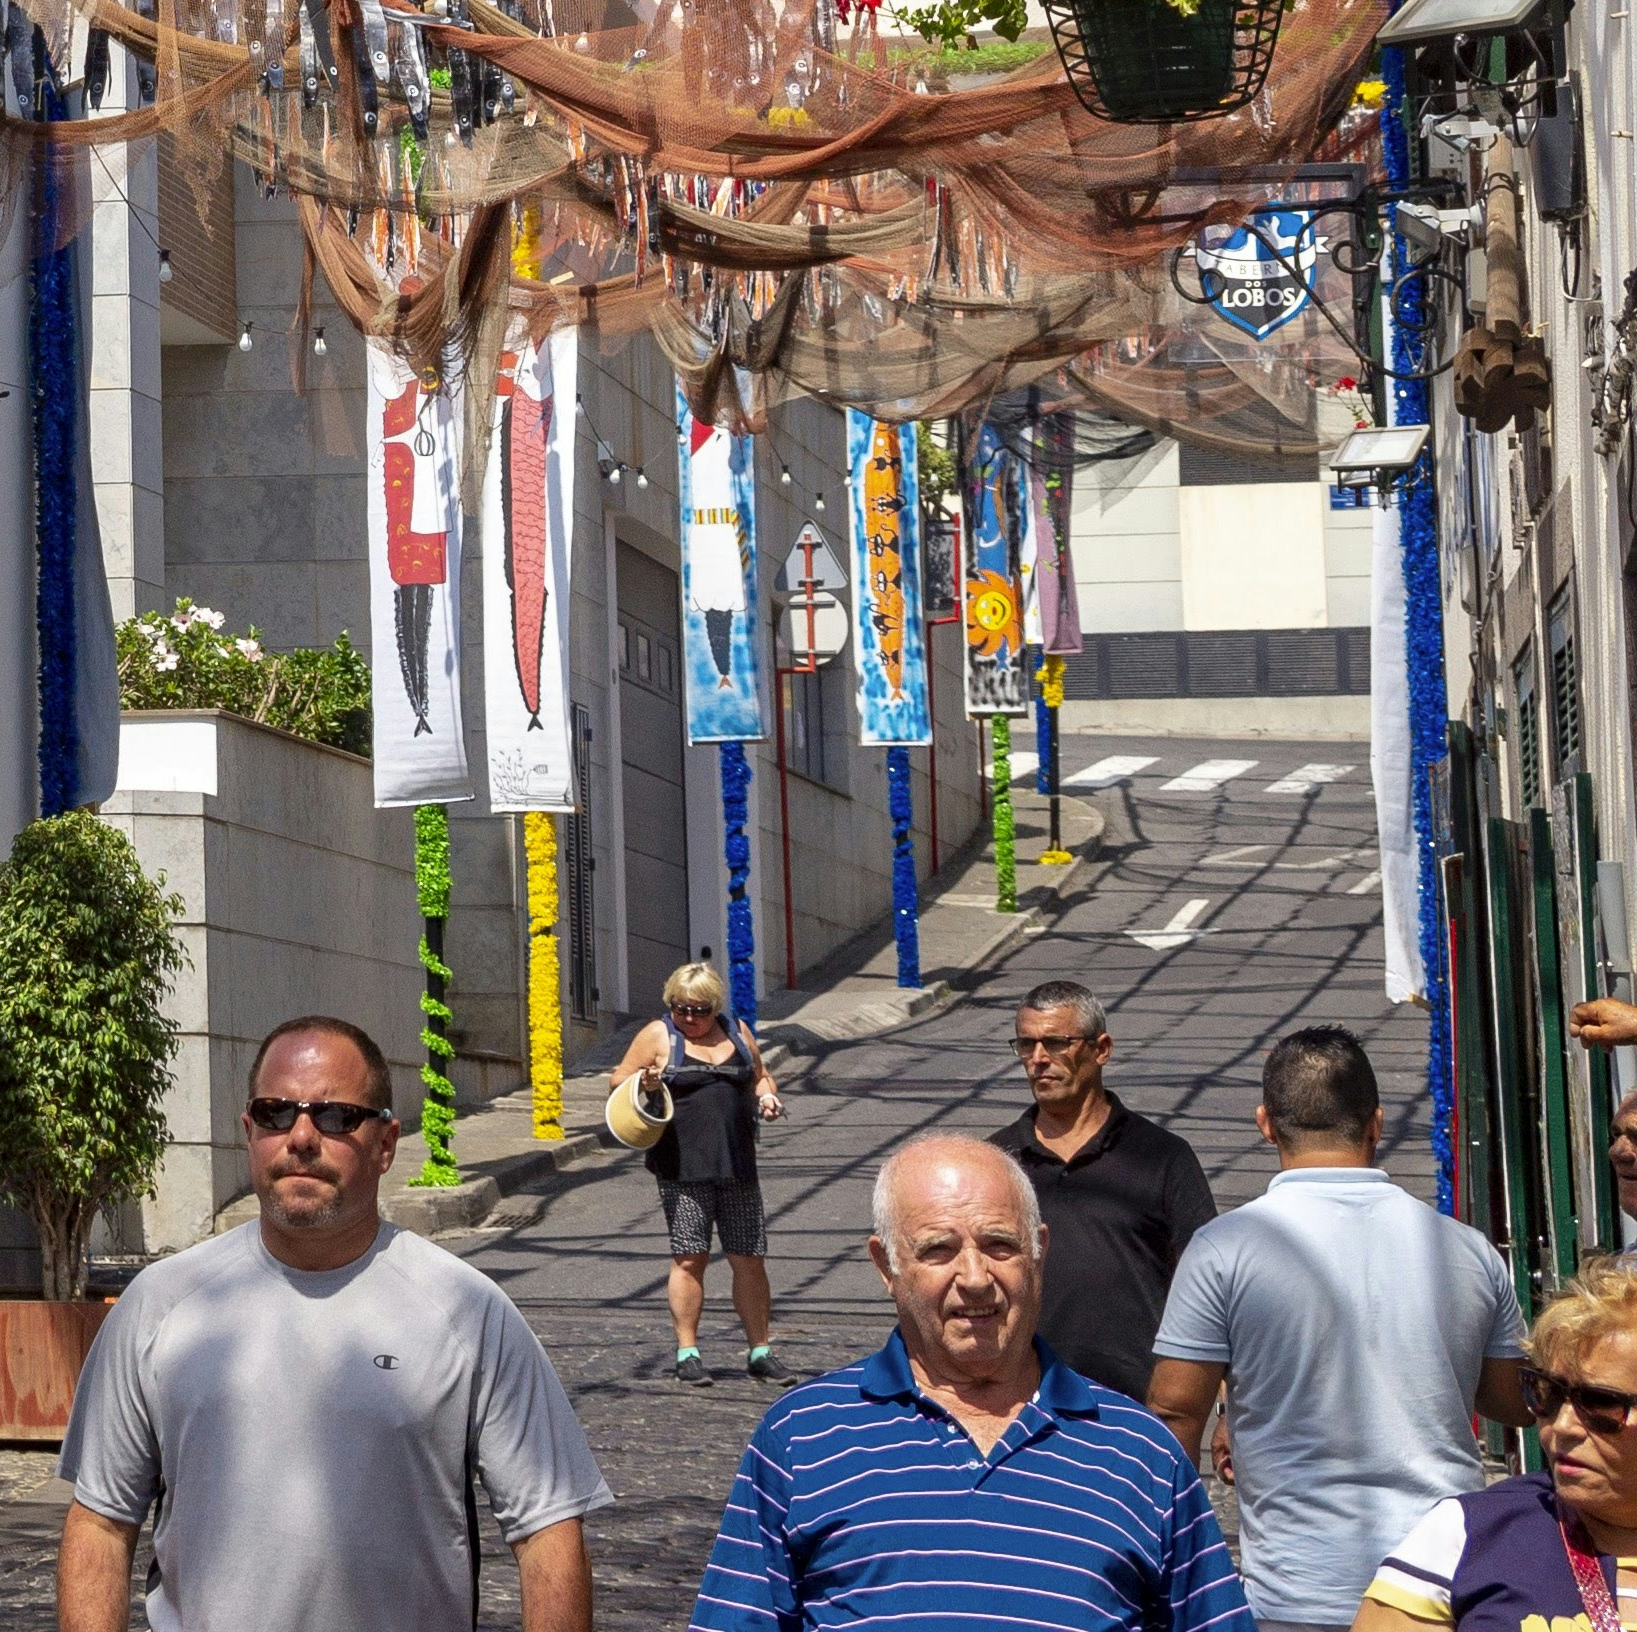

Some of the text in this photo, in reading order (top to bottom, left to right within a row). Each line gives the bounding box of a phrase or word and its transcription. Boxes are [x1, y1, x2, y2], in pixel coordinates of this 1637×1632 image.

[1214, 258, 1287, 276] TABER
[1244, 280, 1267, 288] DOS
[1222, 287, 1296, 308] LOBOS
